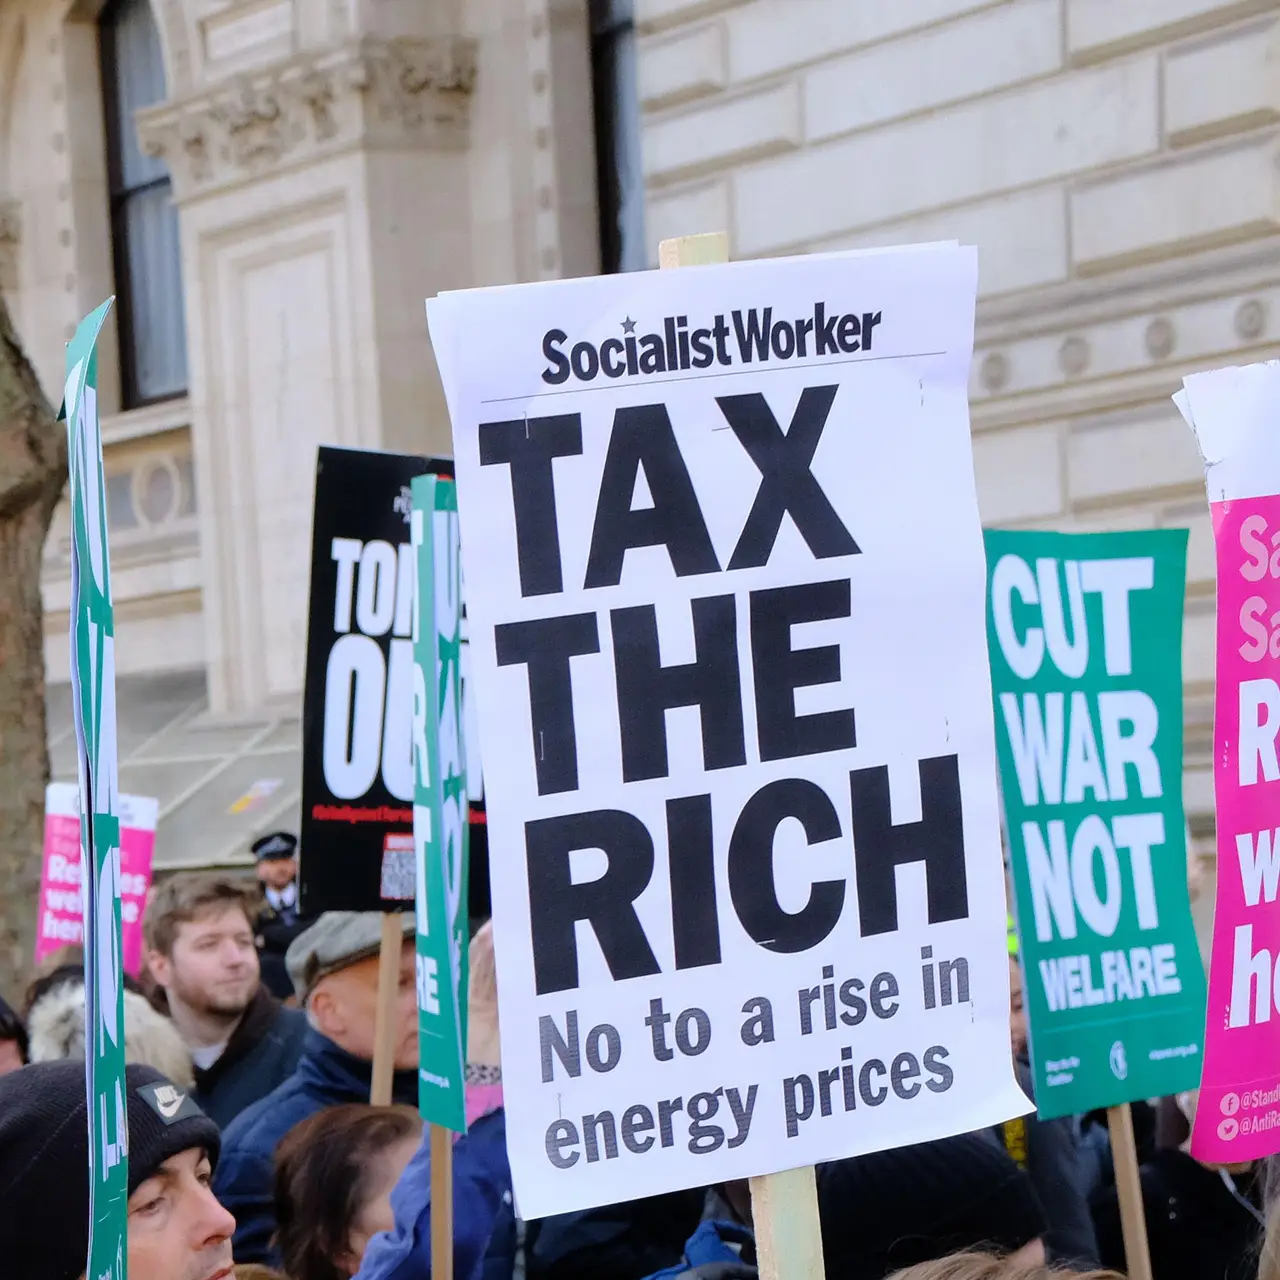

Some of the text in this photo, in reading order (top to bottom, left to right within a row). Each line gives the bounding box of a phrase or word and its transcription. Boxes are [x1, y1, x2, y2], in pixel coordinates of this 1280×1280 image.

[478, 384, 862, 598] TAX
[991, 553, 1154, 680] CUT
[494, 578, 858, 796] THE
[999, 690, 1163, 806] WAR
[524, 754, 970, 996] RICH
[1021, 812, 1166, 943] NOT
[539, 945, 970, 1083] No to a rise in
[1038, 943, 1183, 1012] WELFARE
[545, 1045, 955, 1169] energy prices
[1241, 1083, 1280, 1111] @Stand
